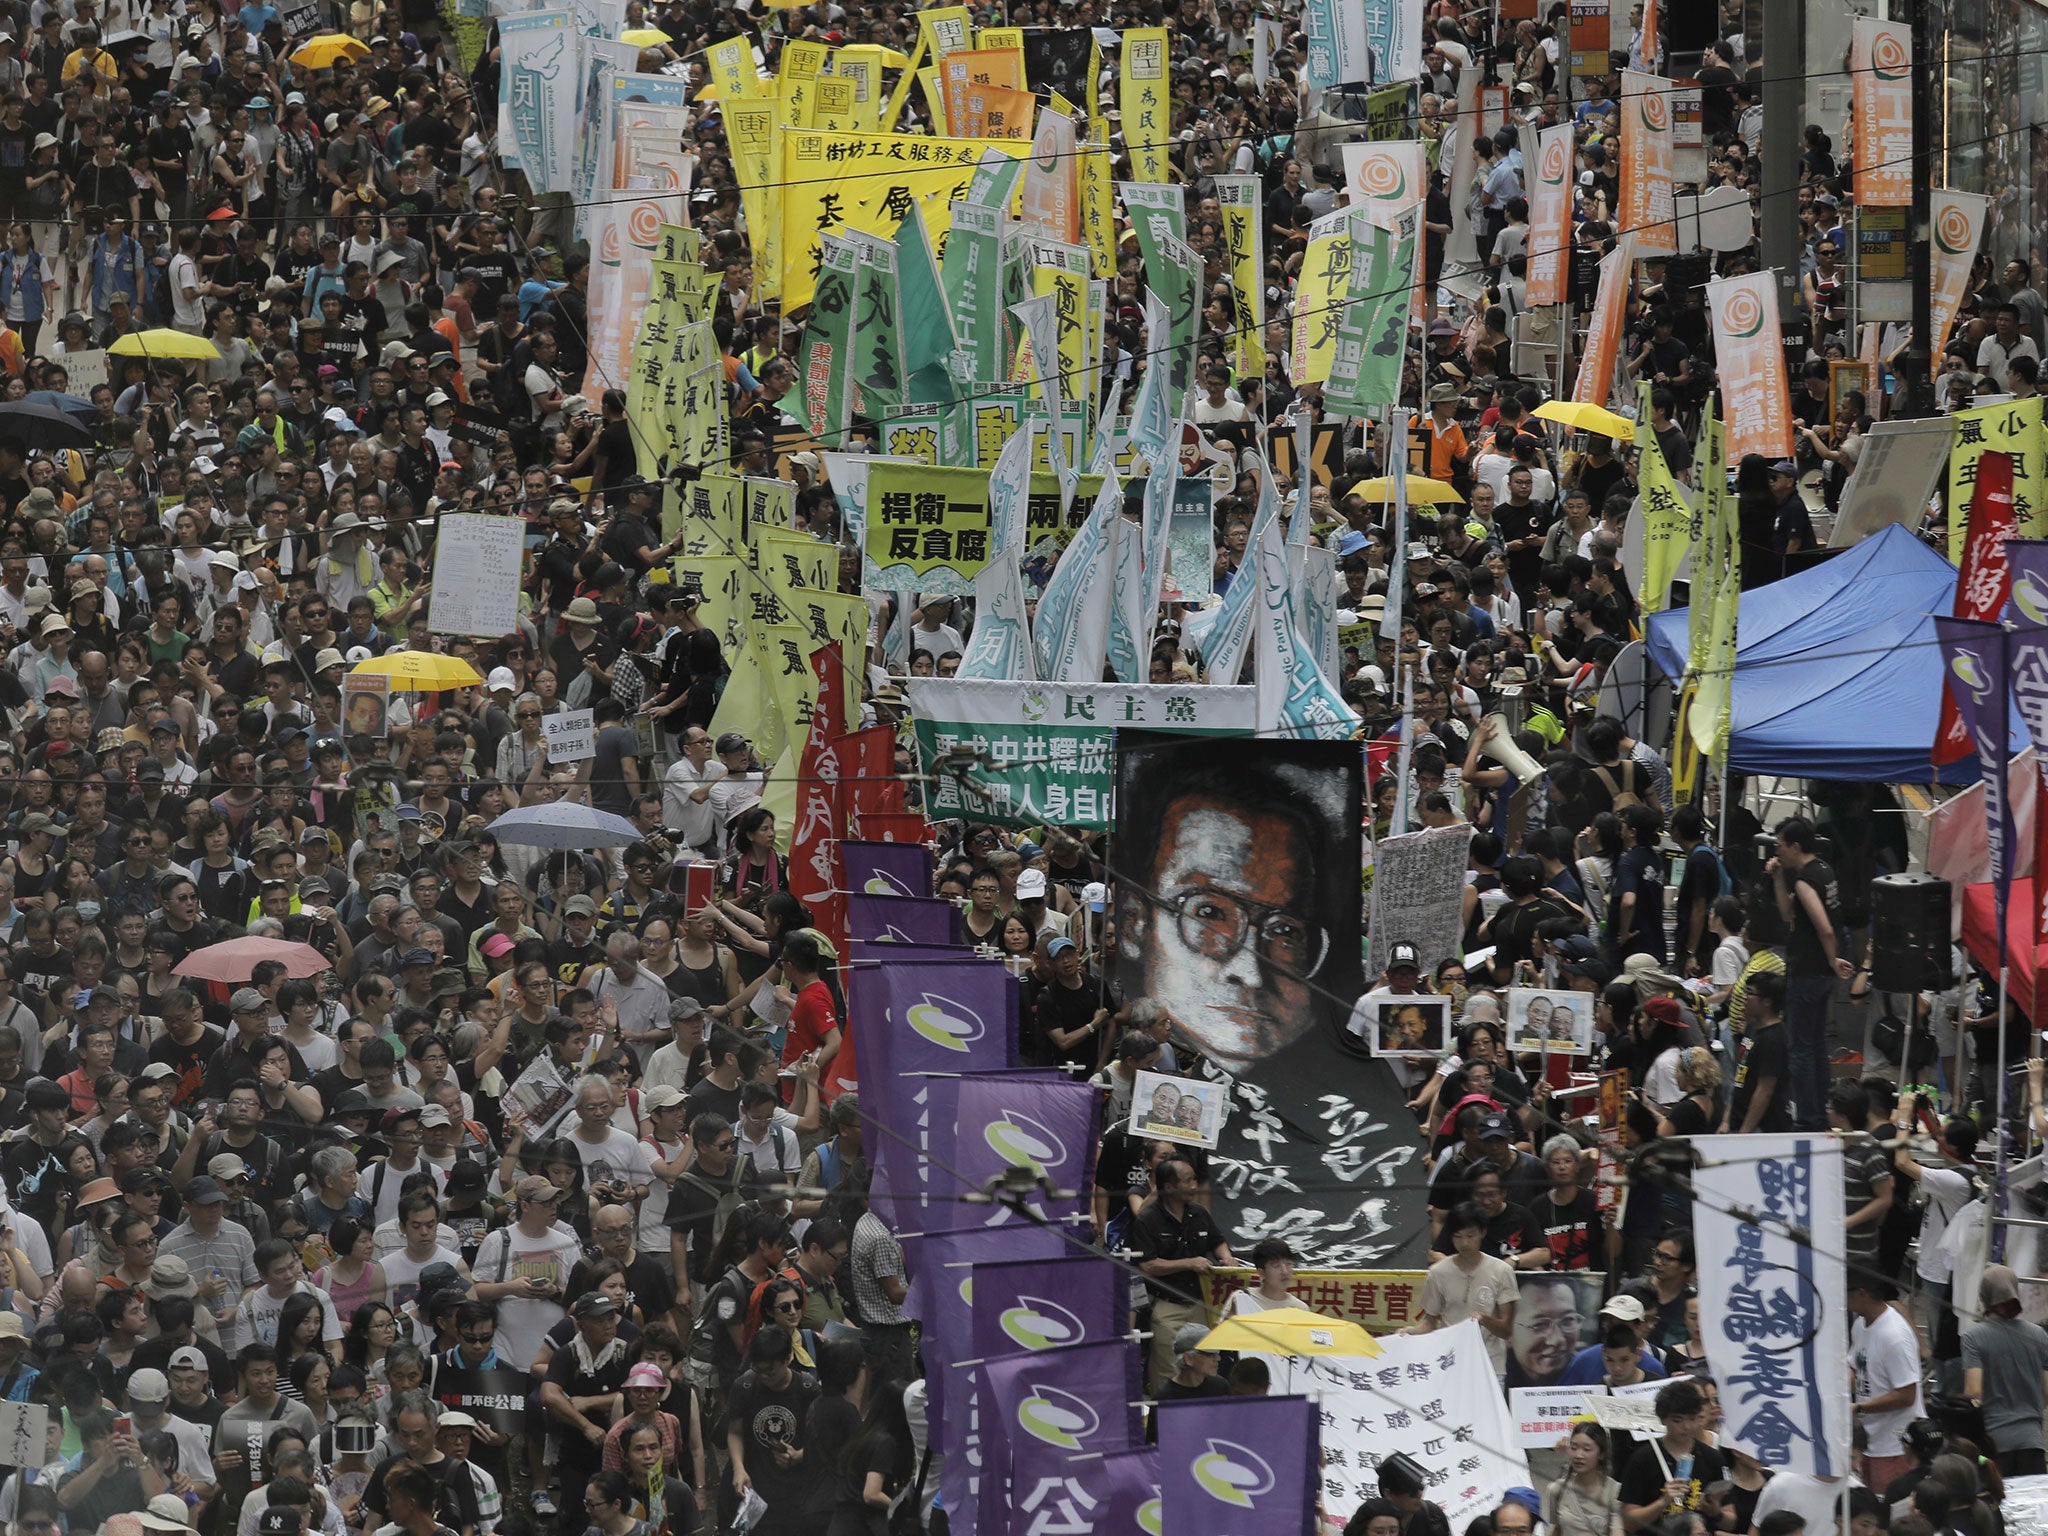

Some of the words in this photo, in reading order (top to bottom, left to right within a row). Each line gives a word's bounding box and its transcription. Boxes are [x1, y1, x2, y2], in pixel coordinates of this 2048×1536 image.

[1571, 7, 1583, 15] 2A
[1585, 7, 1596, 15] 2X
[1676, 103, 1686, 111] 38
[1690, 103, 1700, 111] 42
[1864, 78, 1878, 132] LABOUR
[826, 141, 975, 165] 街坊工友服務處
[1138, 85, 1160, 183] 為民主奮
[1634, 127, 1645, 178] LABOUR
[1879, 86, 1912, 182] 工黨
[1865, 135, 1878, 182] PARTY
[1633, 181, 1645, 223] PARTY
[1863, 231, 1873, 241] 72
[1877, 231, 1888, 241] 77
[881, 492, 1098, 530] 捍衛一兩制
[1174, 502, 1206, 513] 民主黨
[889, 529, 988, 563] 反貪腐
[1272, 618, 1285, 653] Party
[1064, 693, 1198, 723] 民主黨
[934, 732, 1117, 776] 要求中共釋放
[1211, 1275, 1432, 1321] 抗中共草菅
